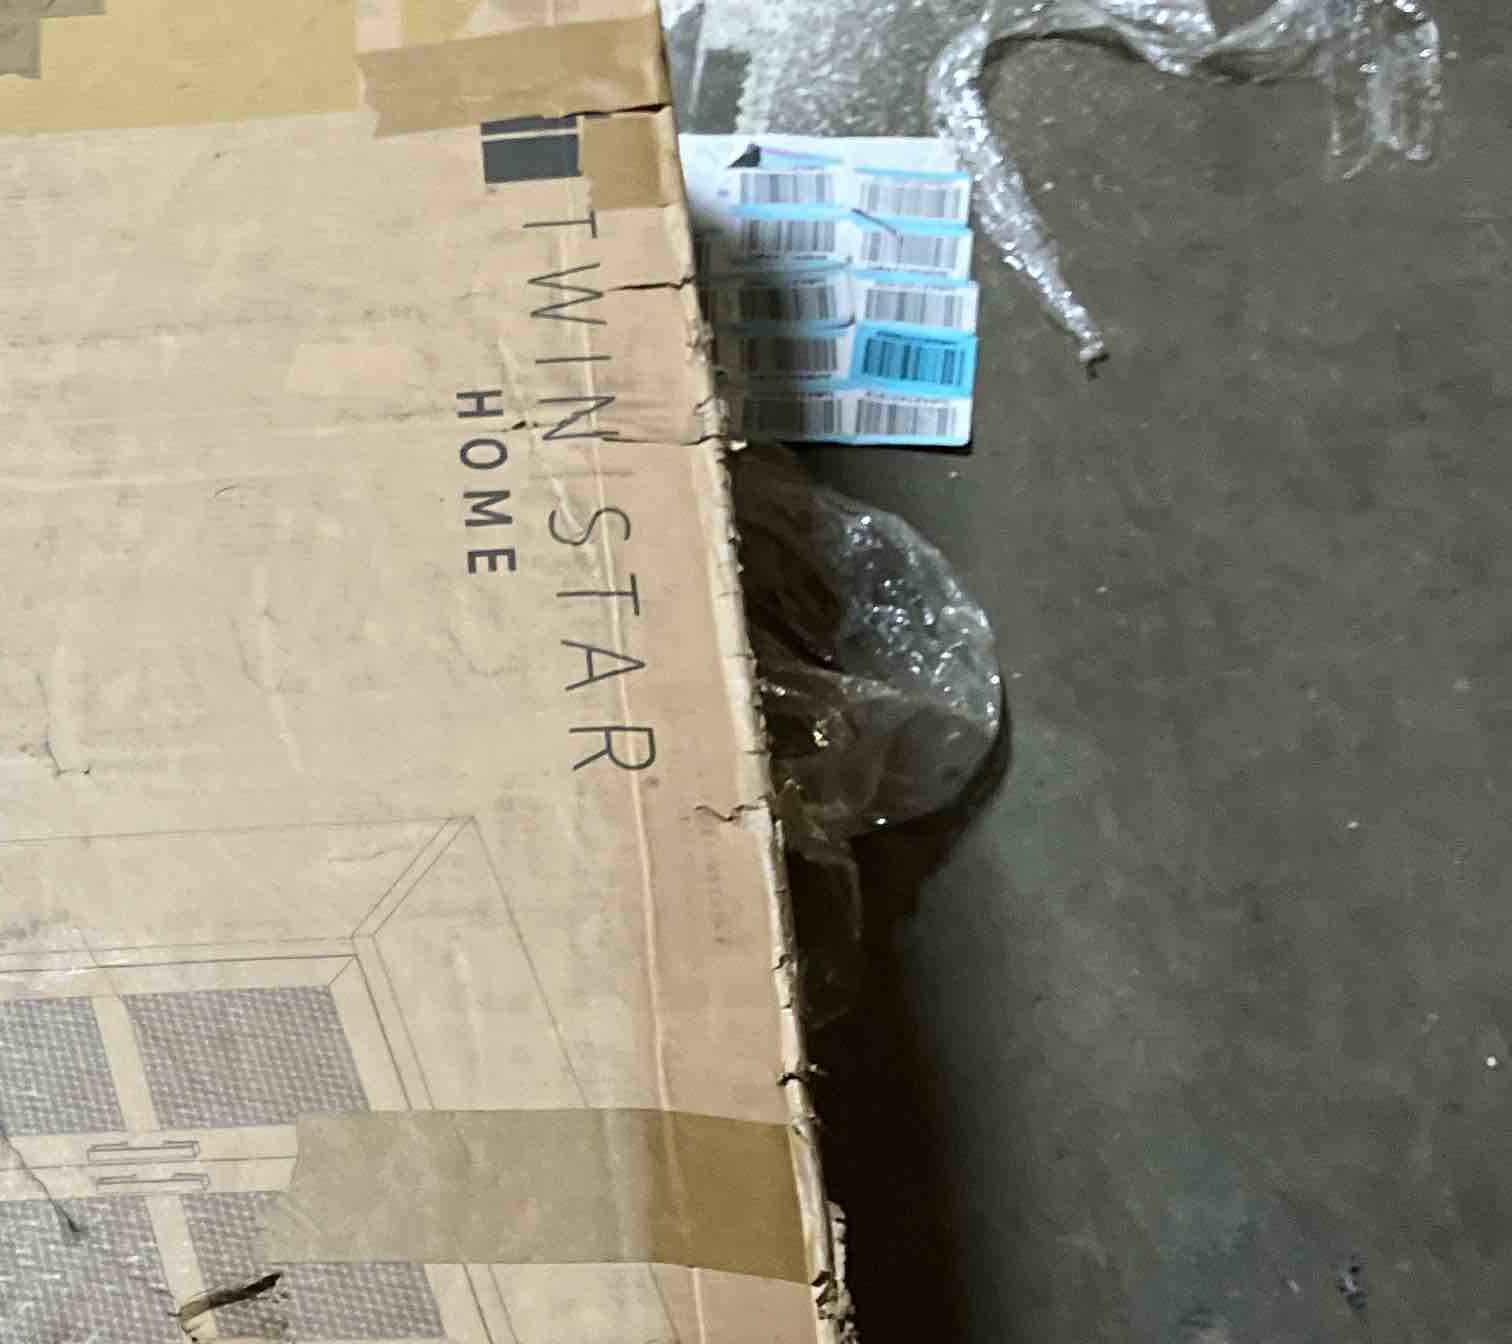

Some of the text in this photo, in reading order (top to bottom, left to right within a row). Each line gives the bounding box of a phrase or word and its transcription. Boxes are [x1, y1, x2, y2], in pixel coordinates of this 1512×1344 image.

[455, 389, 516, 575] HOME
[522, 209, 657, 771] TWIN STAR
